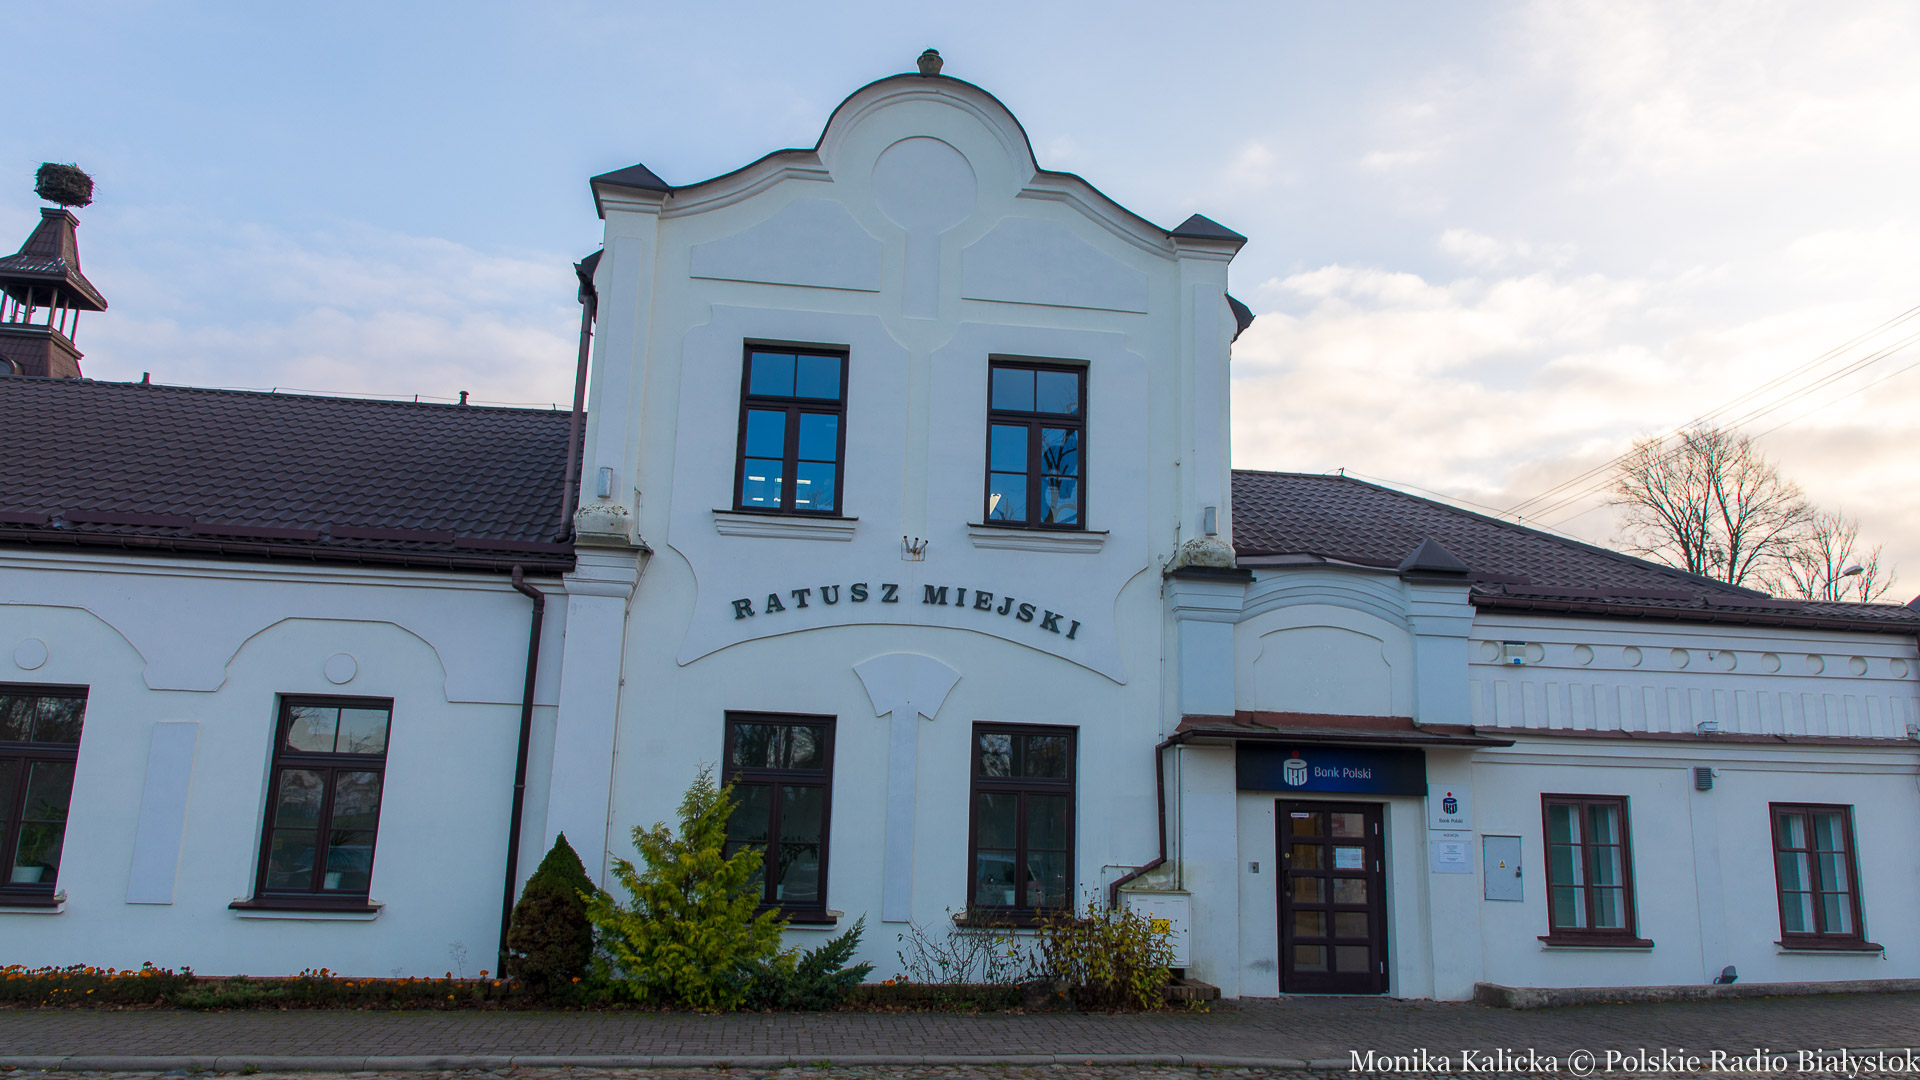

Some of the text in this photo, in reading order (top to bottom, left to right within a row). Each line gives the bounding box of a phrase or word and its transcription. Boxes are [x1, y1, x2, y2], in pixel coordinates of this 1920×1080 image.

[732, 583, 1081, 639] RATUSZ MIEJSKI
[1314, 766, 1371, 779] Bank Polski
